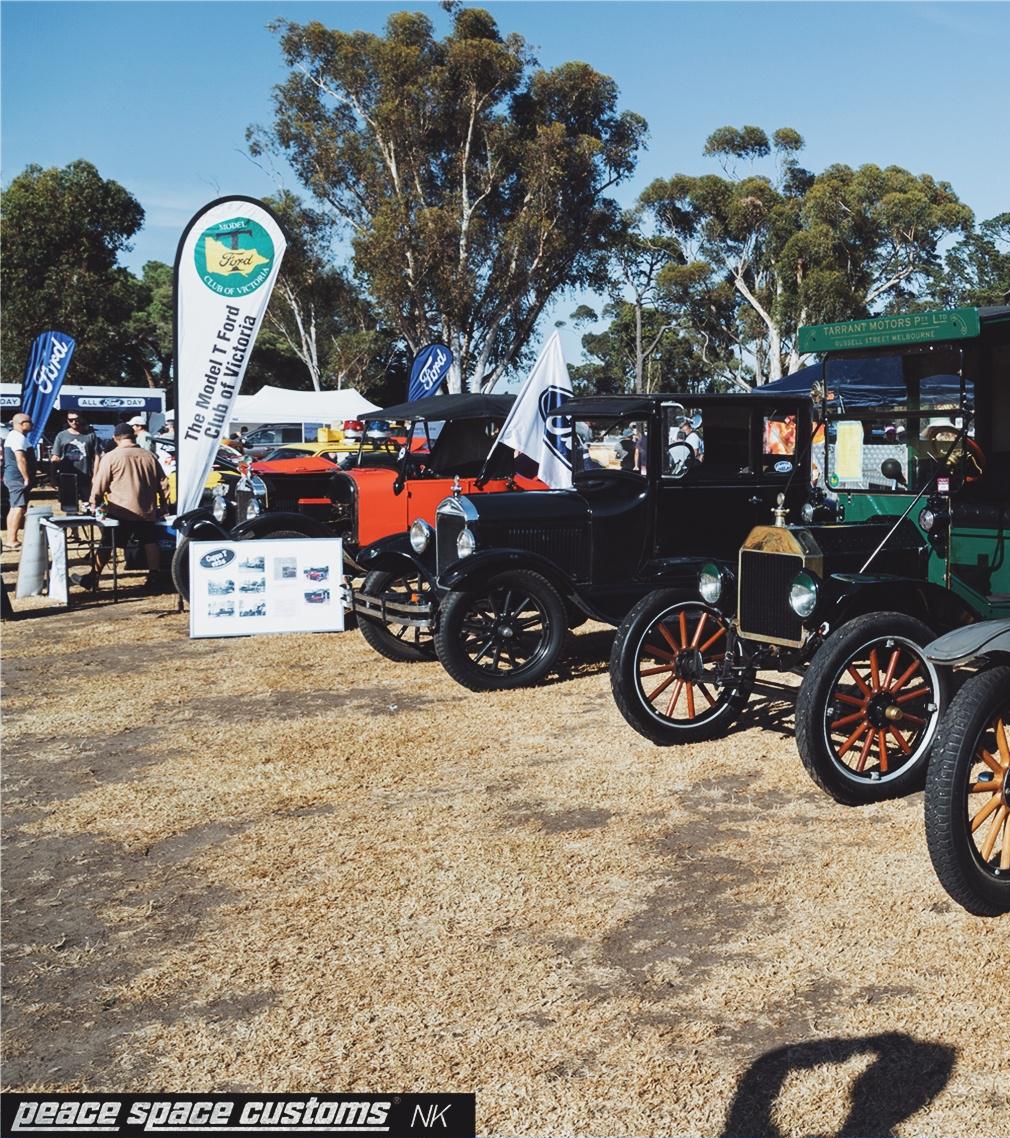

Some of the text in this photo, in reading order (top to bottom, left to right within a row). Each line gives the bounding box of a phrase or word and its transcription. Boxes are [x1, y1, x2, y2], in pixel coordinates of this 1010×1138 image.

[218, 221, 248, 231] MODEL
[218, 252, 254, 267] Ford
[203, 267, 270, 296] CLUB OF VICTORIA
[823, 322, 867, 336] TARRANT
[869, 317, 912, 331] MOTORS
[33, 336, 69, 394] Ford
[184, 304, 240, 441] The Model T Ford
[204, 315, 257, 440] Club of Victoria
[419, 348, 447, 391] Ford
